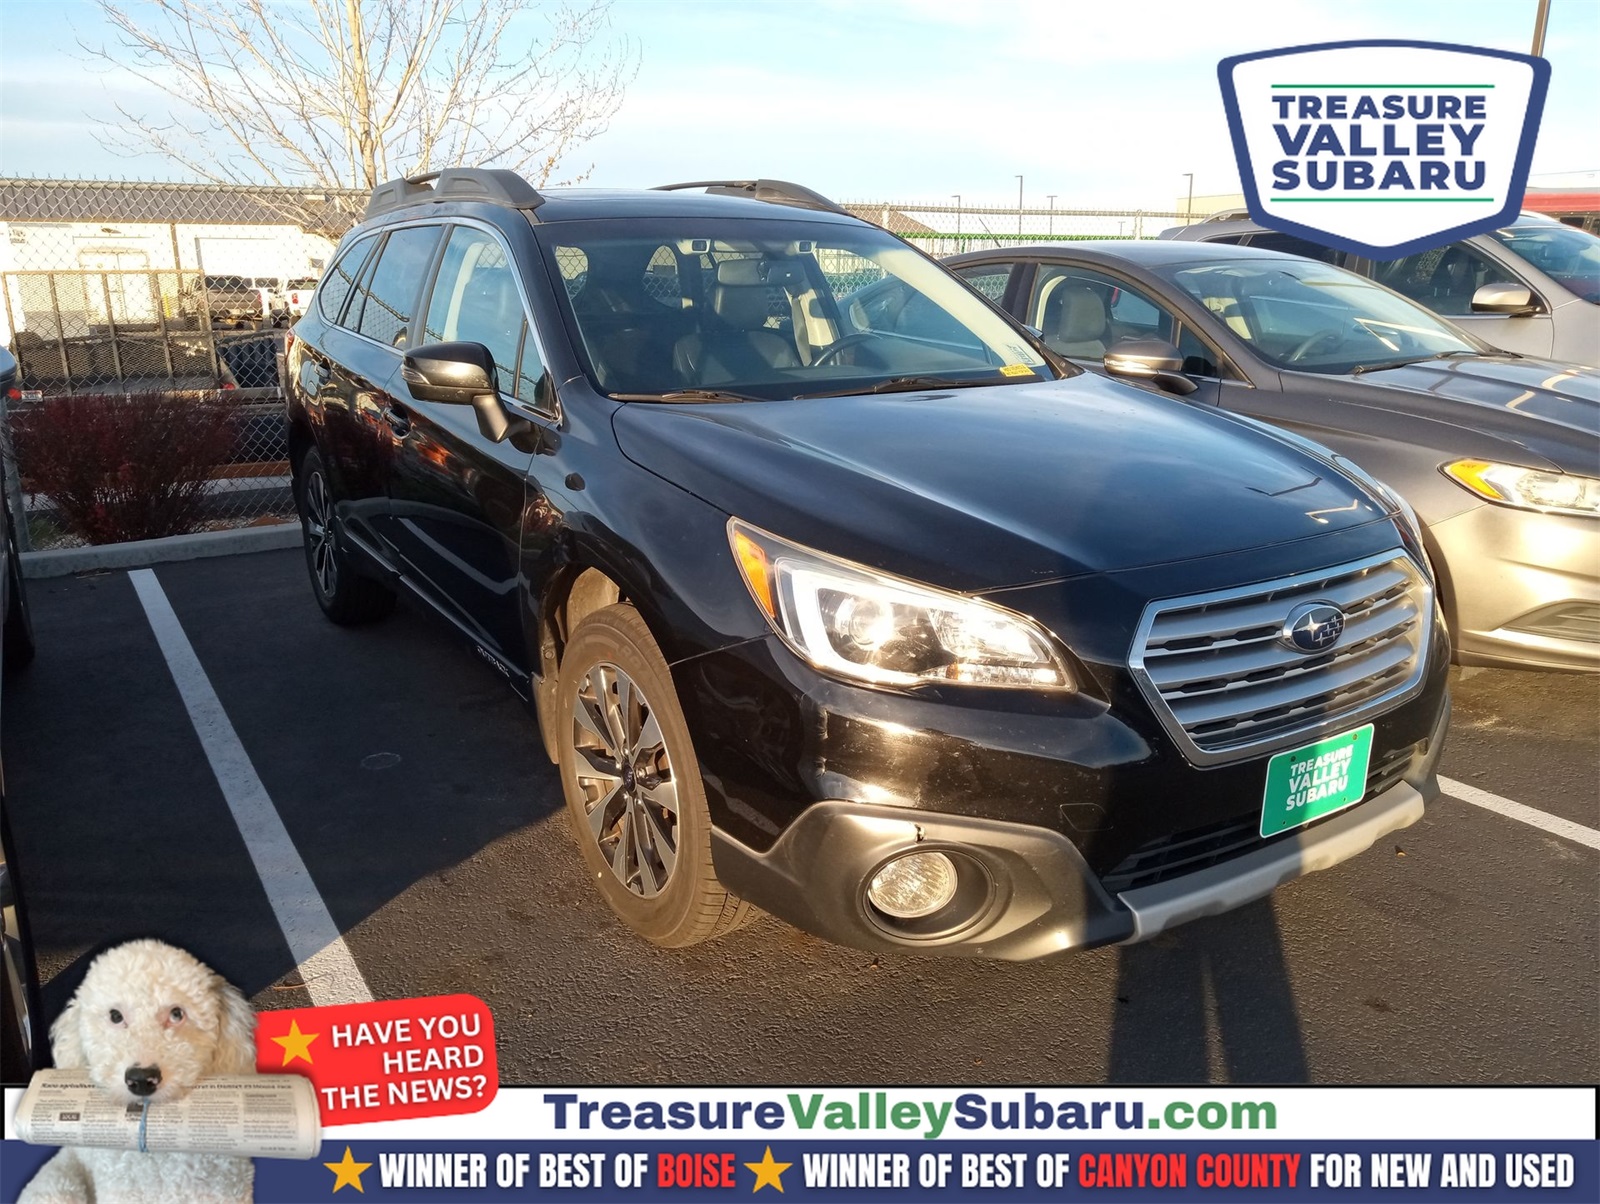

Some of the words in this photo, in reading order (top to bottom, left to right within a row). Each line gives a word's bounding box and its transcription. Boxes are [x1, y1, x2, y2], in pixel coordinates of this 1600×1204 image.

[1288, 757, 1352, 794] VALLEY
[1290, 744, 1354, 777] TREASURE
[1285, 774, 1349, 812] SUBARU
